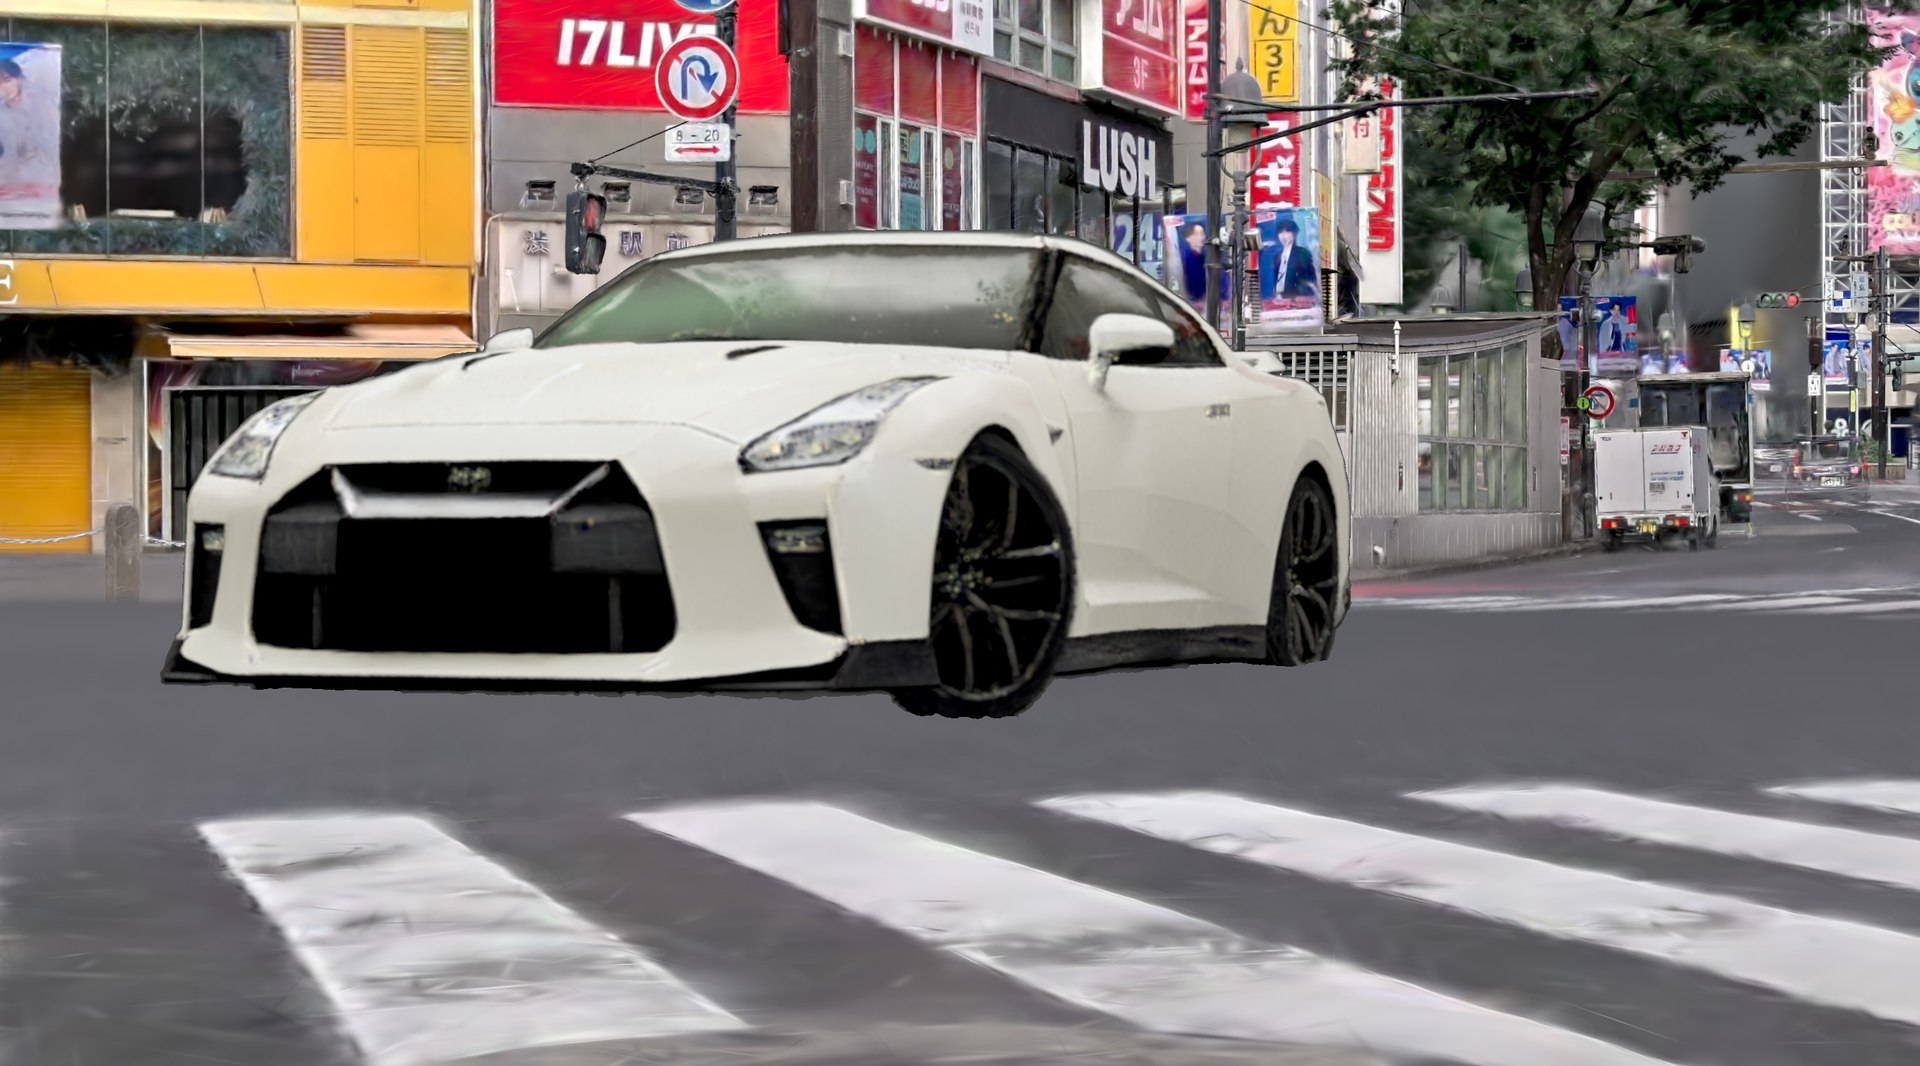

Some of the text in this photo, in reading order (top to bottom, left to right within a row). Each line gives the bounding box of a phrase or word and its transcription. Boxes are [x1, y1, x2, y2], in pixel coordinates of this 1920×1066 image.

[557, 19, 717, 68] 17LIV
[1133, 55, 1149, 91] 3F
[1187, 19, 1208, 84] アコム
[1083, 119, 1156, 199] LUSH
[1254, 120, 1296, 209] スギ
